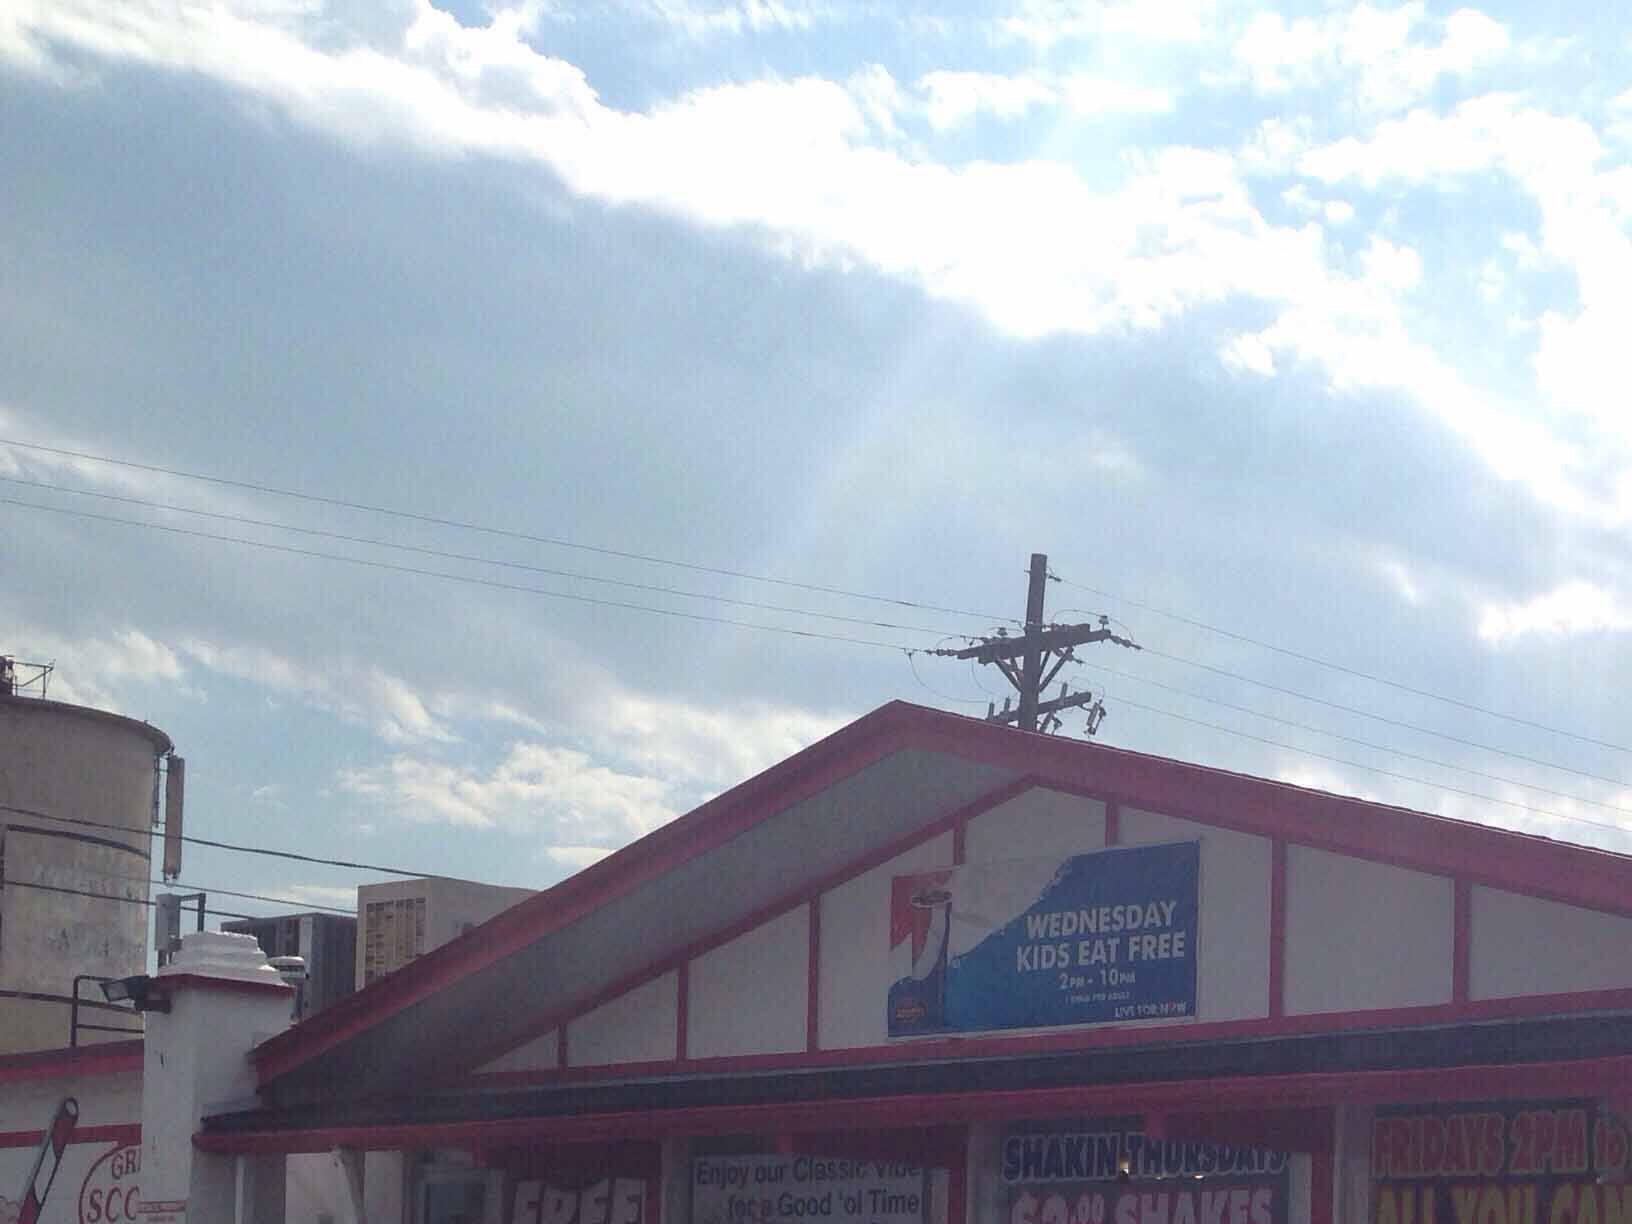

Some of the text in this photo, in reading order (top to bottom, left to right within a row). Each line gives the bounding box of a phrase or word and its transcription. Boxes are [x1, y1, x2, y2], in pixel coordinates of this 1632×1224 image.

[1026, 900, 1177, 940] WEDNESDAY
[1016, 930, 1186, 973] KIDS EAT FREE
[1002, 1131, 1120, 1184] SHAKIN
[1370, 1112, 1506, 1177] FRIDAYS
[1509, 1107, 1589, 1175] 2PM
[697, 1160, 748, 1189] Enjoy
[755, 1163, 787, 1183] our
[794, 1157, 865, 1182] Classic
[728, 1194, 752, 1217] for
[778, 1191, 832, 1216] Good
[869, 1190, 920, 1214] Time
